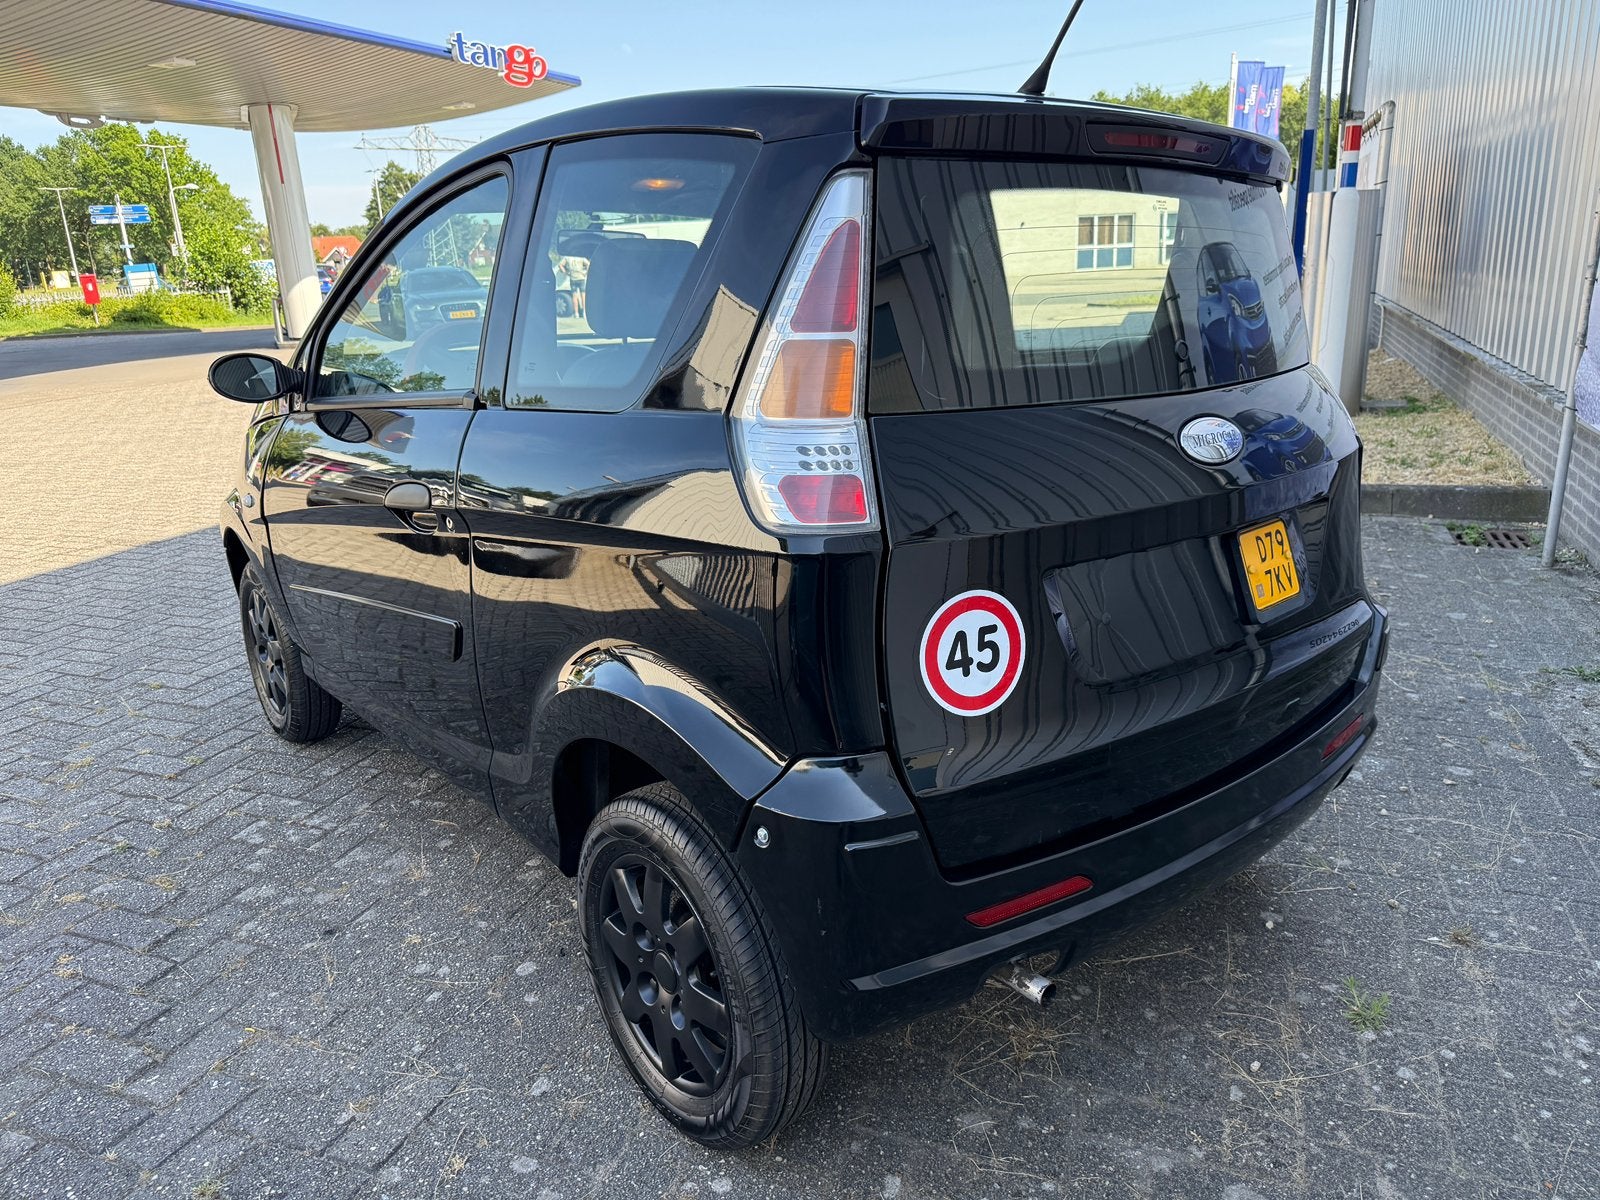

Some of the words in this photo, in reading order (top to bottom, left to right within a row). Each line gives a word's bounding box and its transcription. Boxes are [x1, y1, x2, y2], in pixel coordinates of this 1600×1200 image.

[451, 32, 548, 88] tango
[1256, 529, 1285, 563] D79
[1265, 562, 1293, 597] 7KV
[945, 624, 1000, 678] 45
